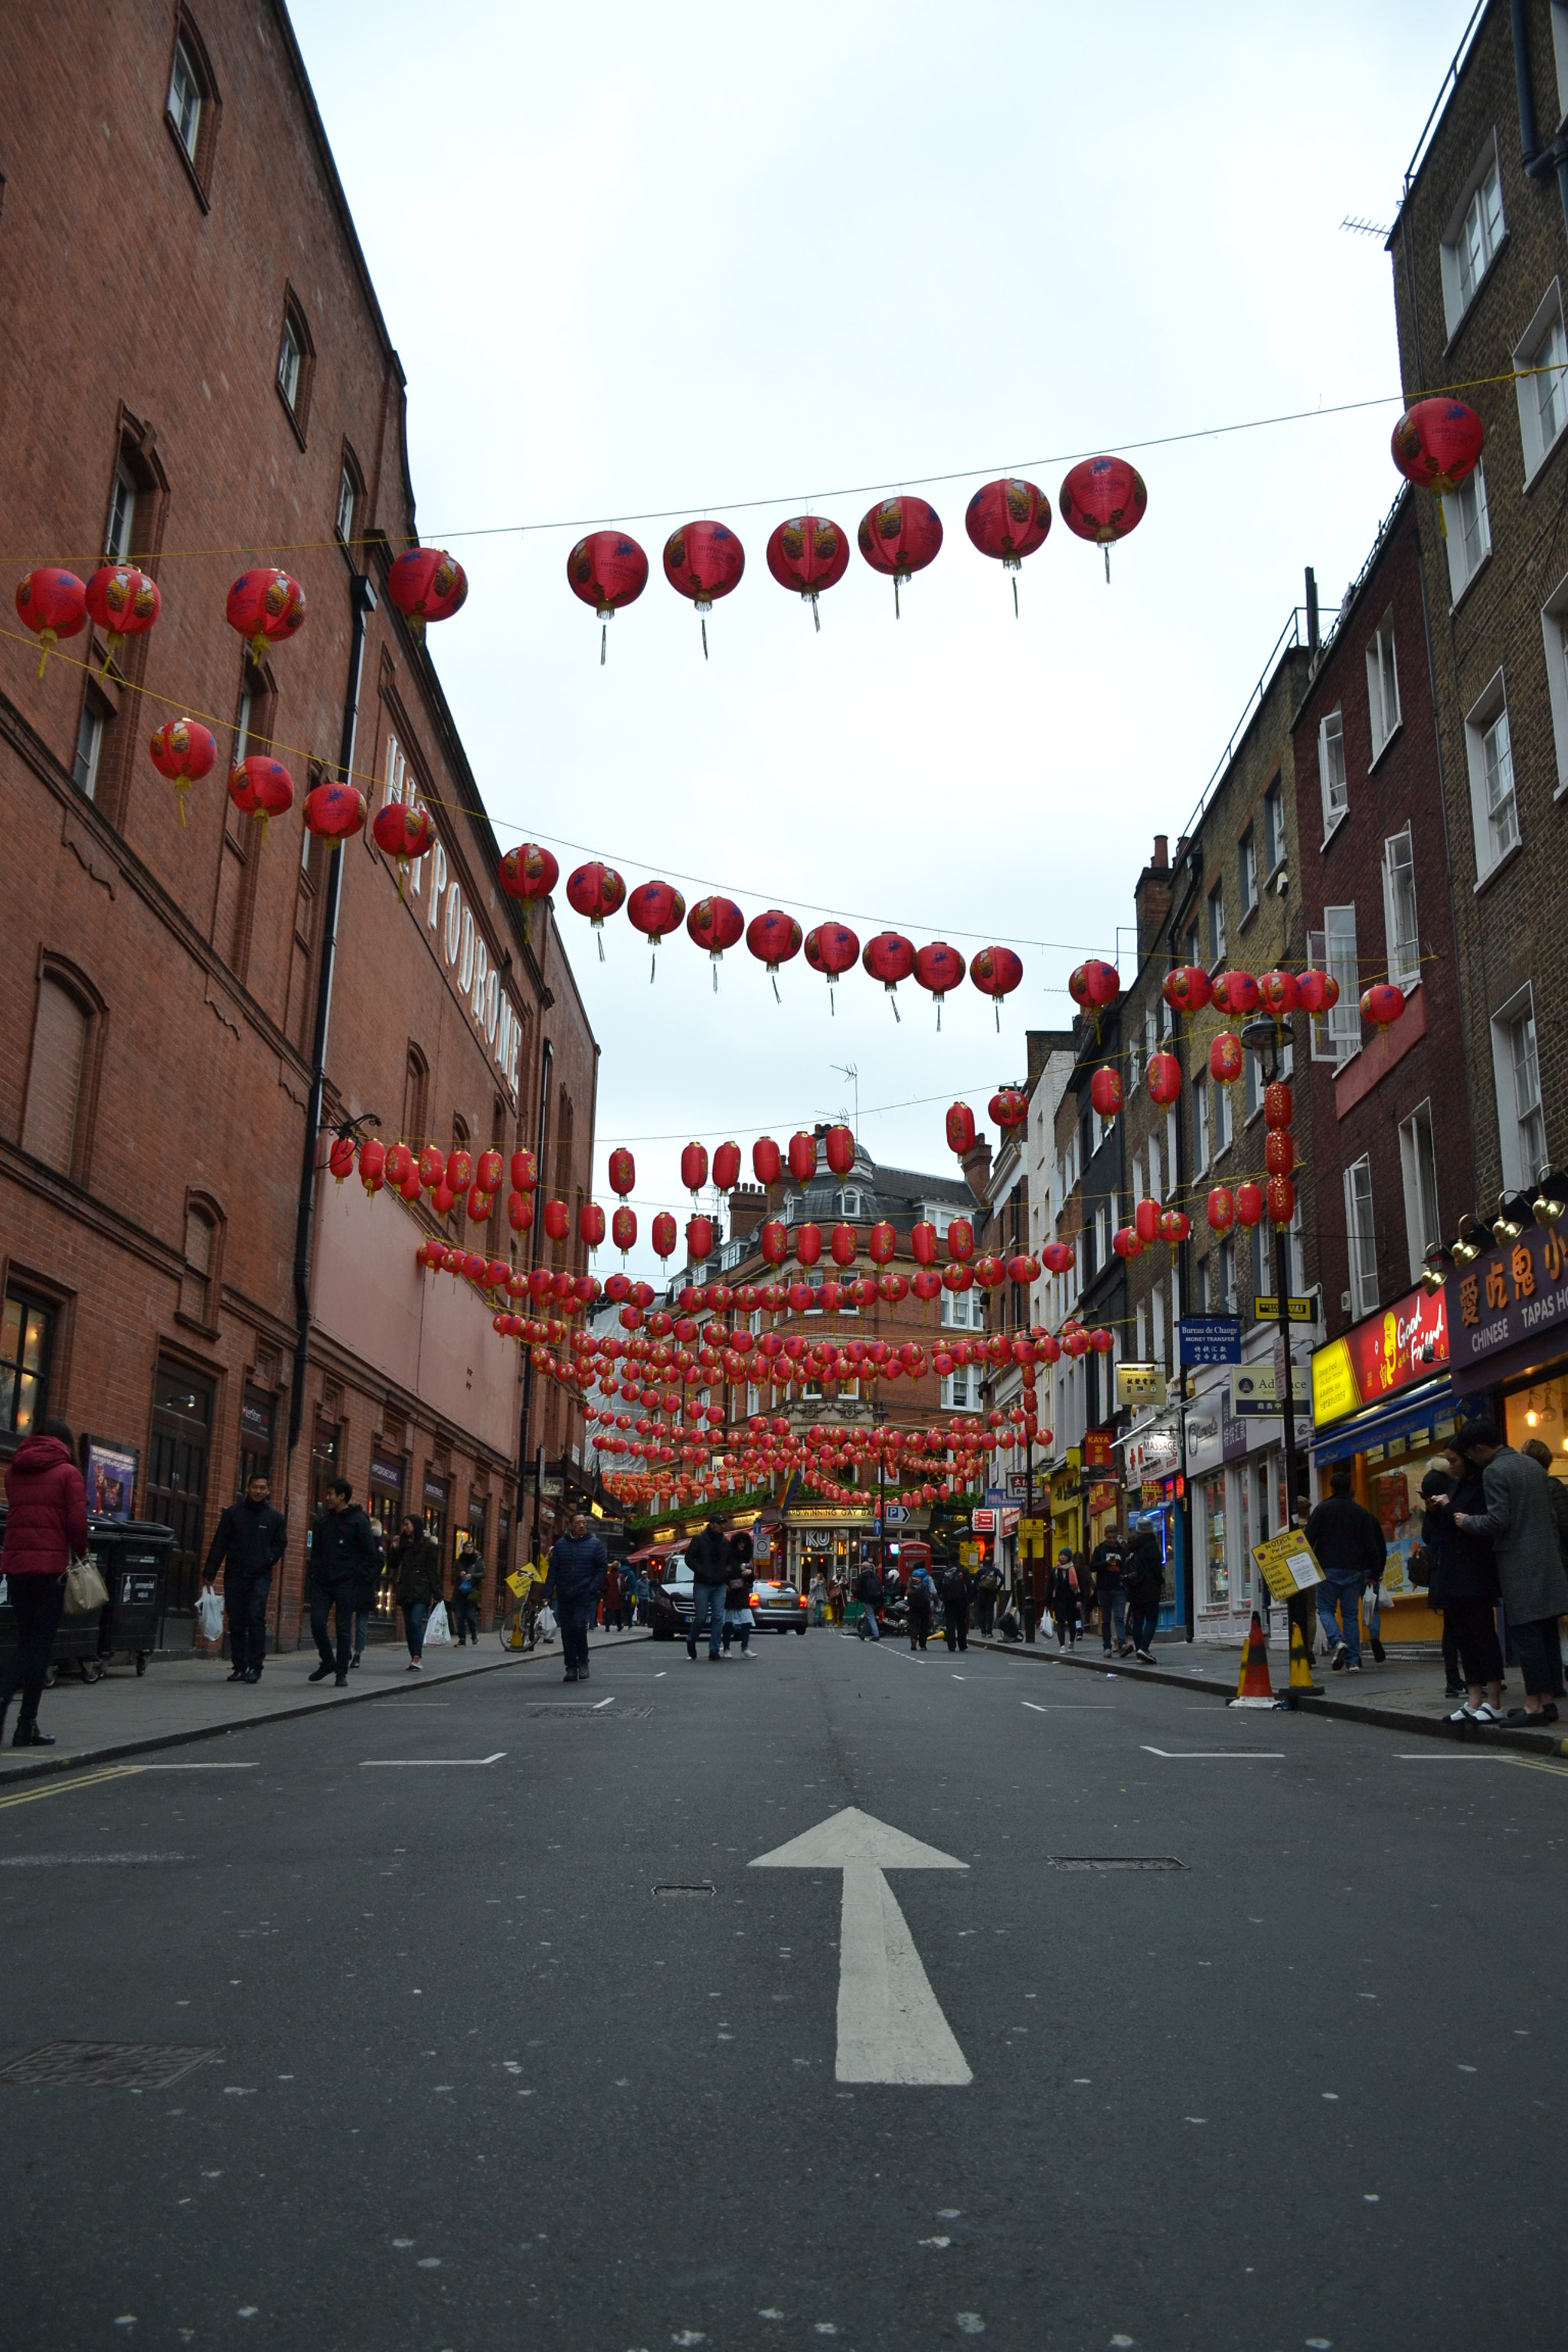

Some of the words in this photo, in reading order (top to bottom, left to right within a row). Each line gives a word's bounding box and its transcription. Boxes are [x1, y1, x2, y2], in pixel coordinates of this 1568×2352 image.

[1397, 1295, 1423, 1349] Good
[1472, 1318, 1509, 1353] CHINESE
[1522, 1295, 1556, 1328] TAPAS
[1214, 1326, 1238, 1335] Change
[1259, 1379, 1307, 1389] Adce
[1143, 1441, 1177, 1451] MASSAGE
[890, 1508, 897, 1517] P
[805, 1530, 831, 1547] KU
[1265, 1535, 1292, 1550] NOTICE
